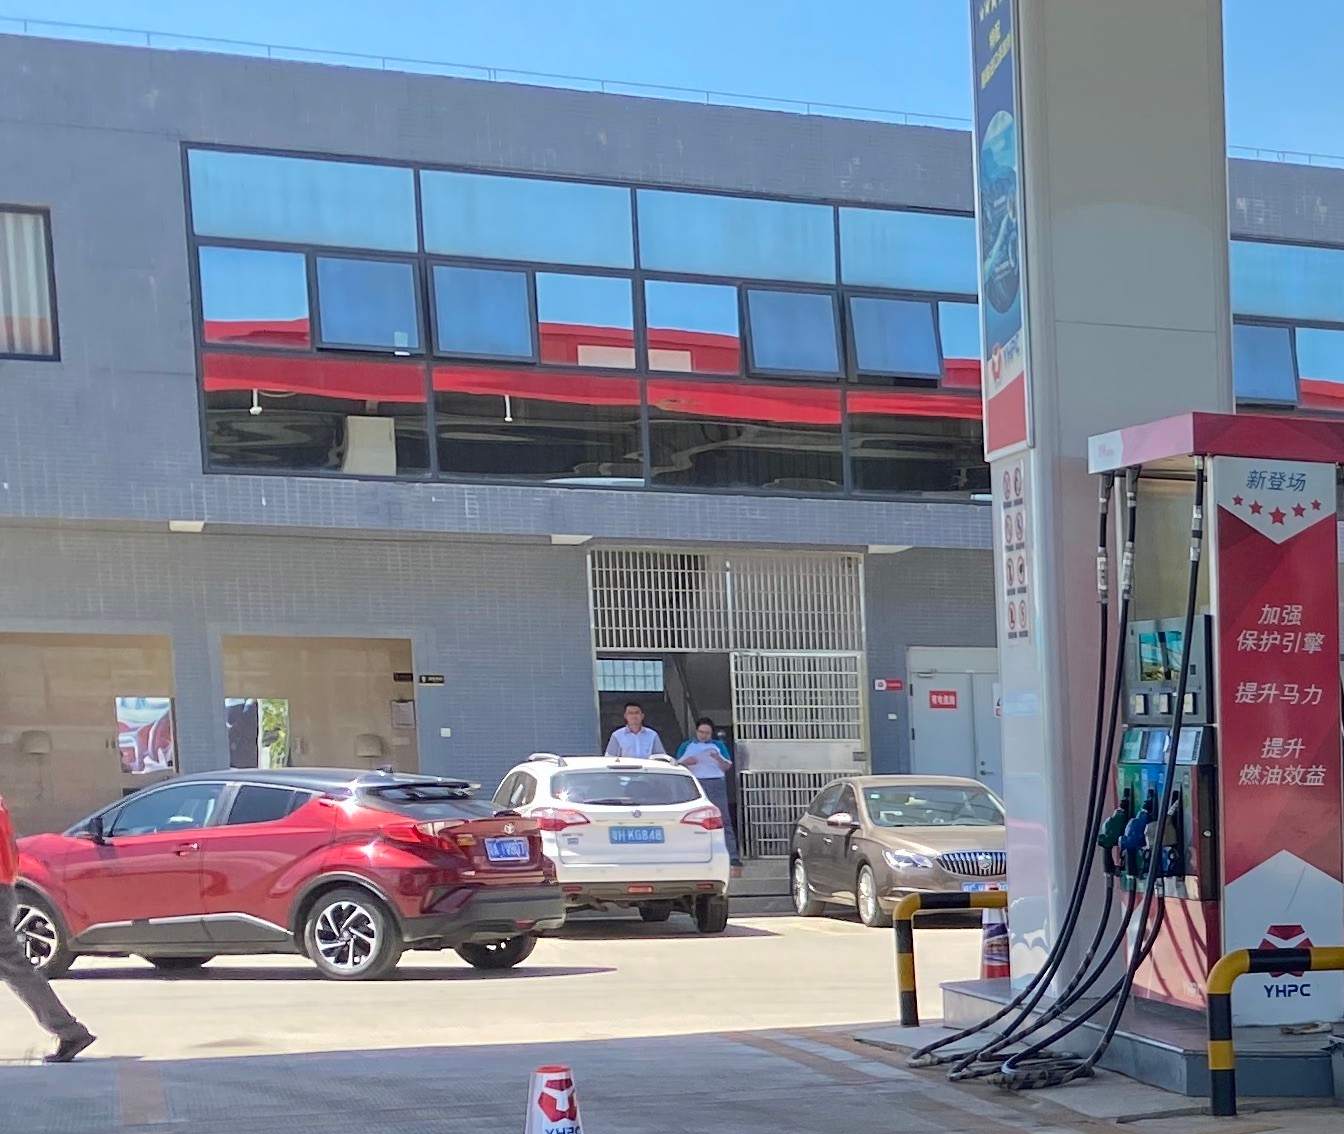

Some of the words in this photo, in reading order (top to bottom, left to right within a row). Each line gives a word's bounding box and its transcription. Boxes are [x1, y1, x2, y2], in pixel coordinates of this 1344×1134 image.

[1246, 470, 1307, 492] 新登场
[1257, 603, 1303, 626] 加强
[1236, 630, 1327, 654] 保护引擎
[1234, 682, 1323, 706] 提升马力
[1260, 736, 1306, 760] 提升
[1238, 764, 1327, 788] 燃油效益
[1264, 983, 1311, 998] YHPC
